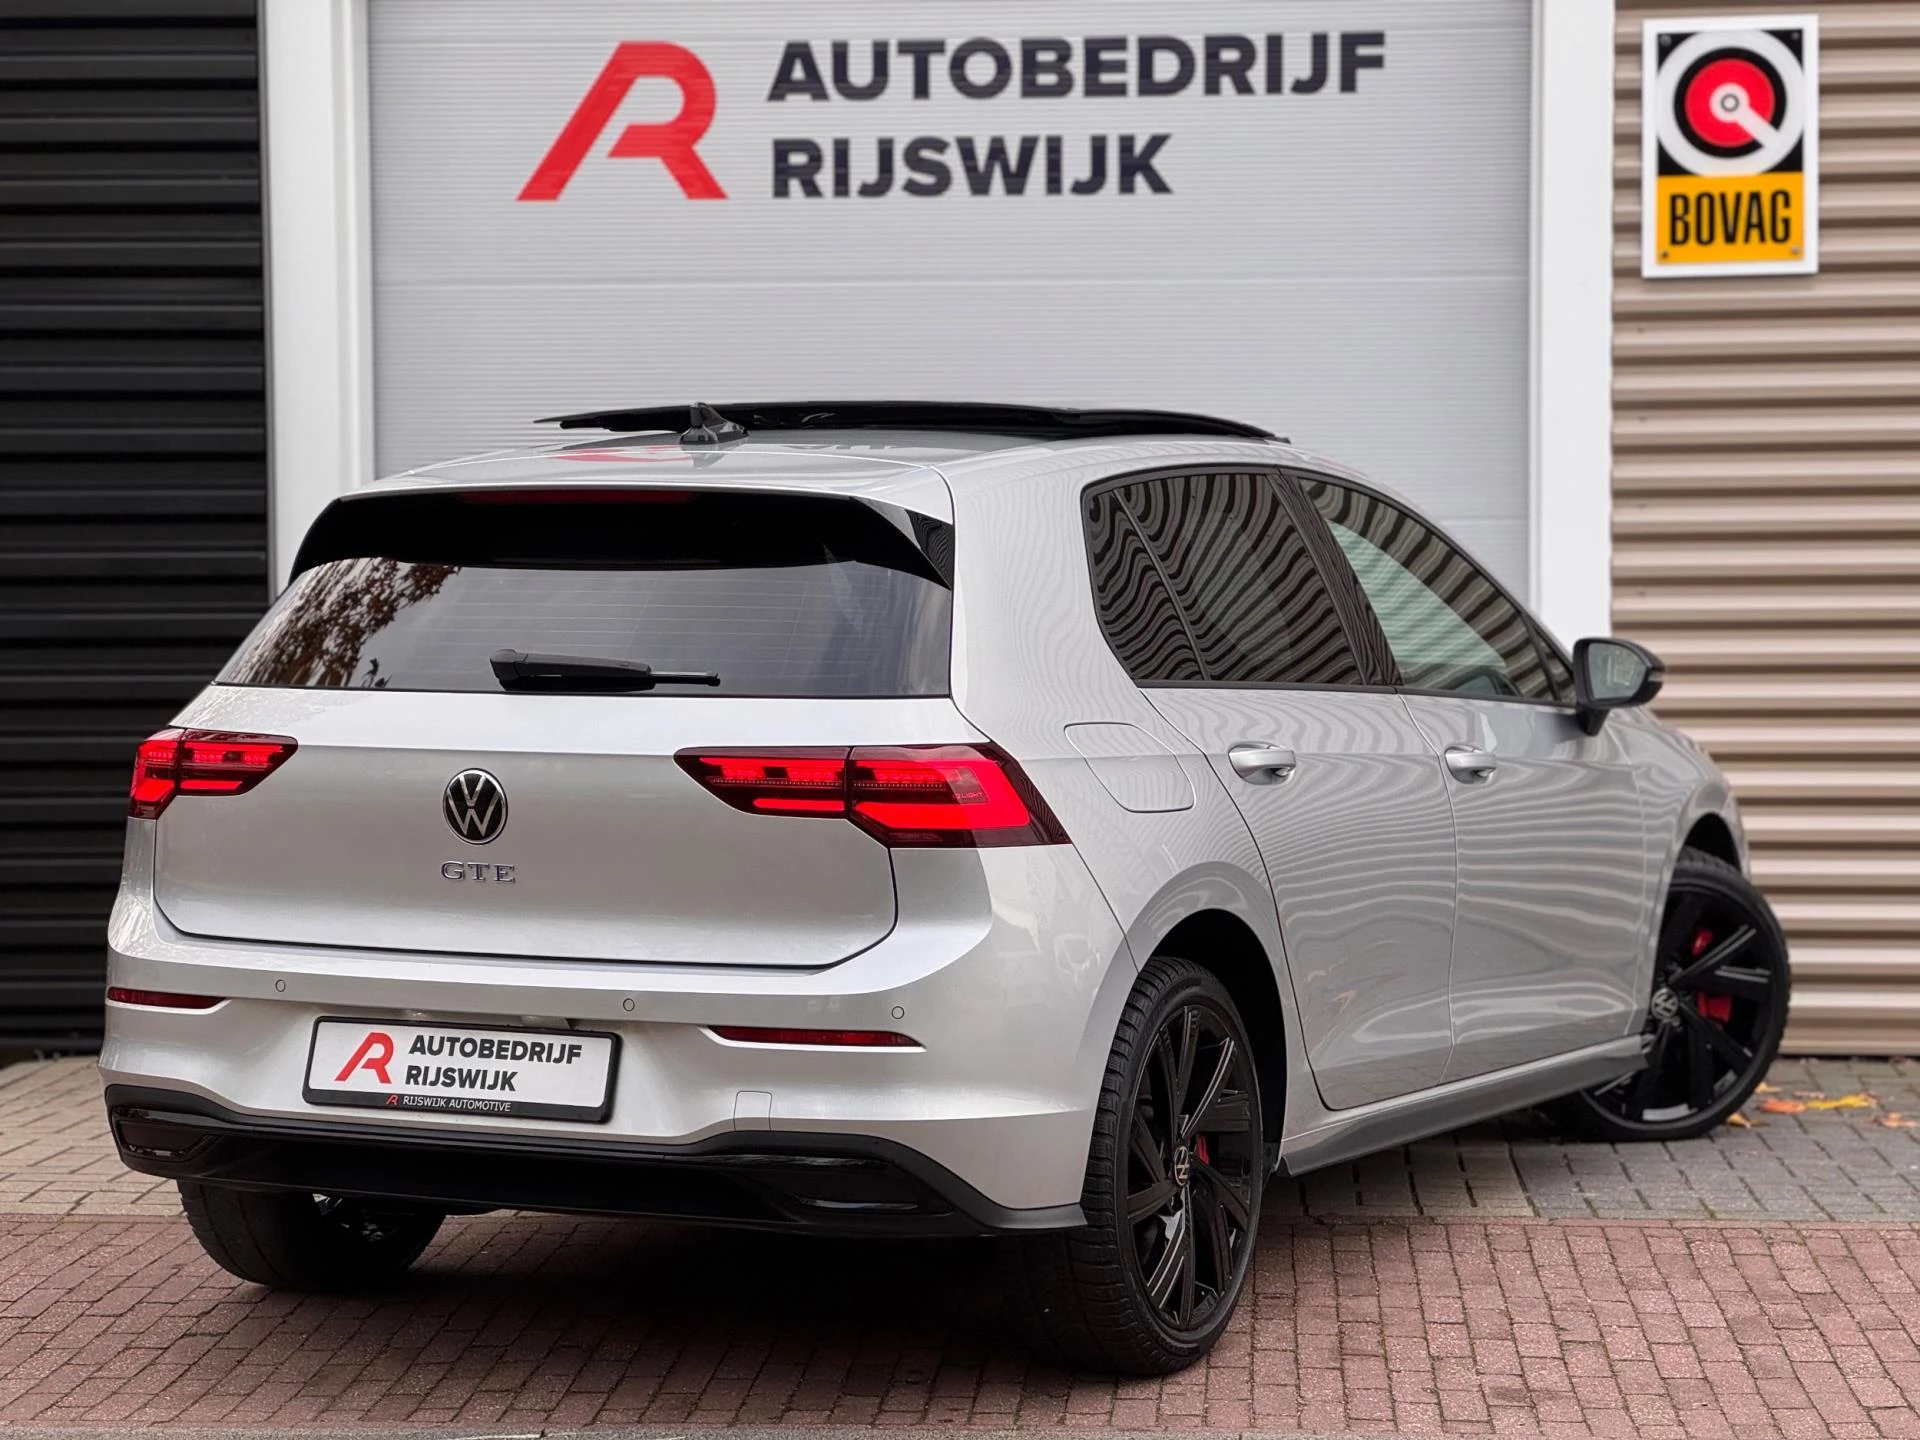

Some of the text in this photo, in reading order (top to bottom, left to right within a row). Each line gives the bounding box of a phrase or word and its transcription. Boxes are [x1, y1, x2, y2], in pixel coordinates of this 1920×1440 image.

[767, 30, 1386, 102] AUTOBEDRIJF
[771, 132, 1174, 200] RIJSWIJK
[1669, 188, 1792, 246] BOVAG
[441, 860, 516, 883] GTE
[408, 1034, 583, 1065] AUTOBEDRIJF
[404, 1066, 519, 1092] RIJSWIJK
[402, 1095, 447, 1108] RIJSWIJK
[448, 1098, 512, 1112] AUTOMOTIVE
